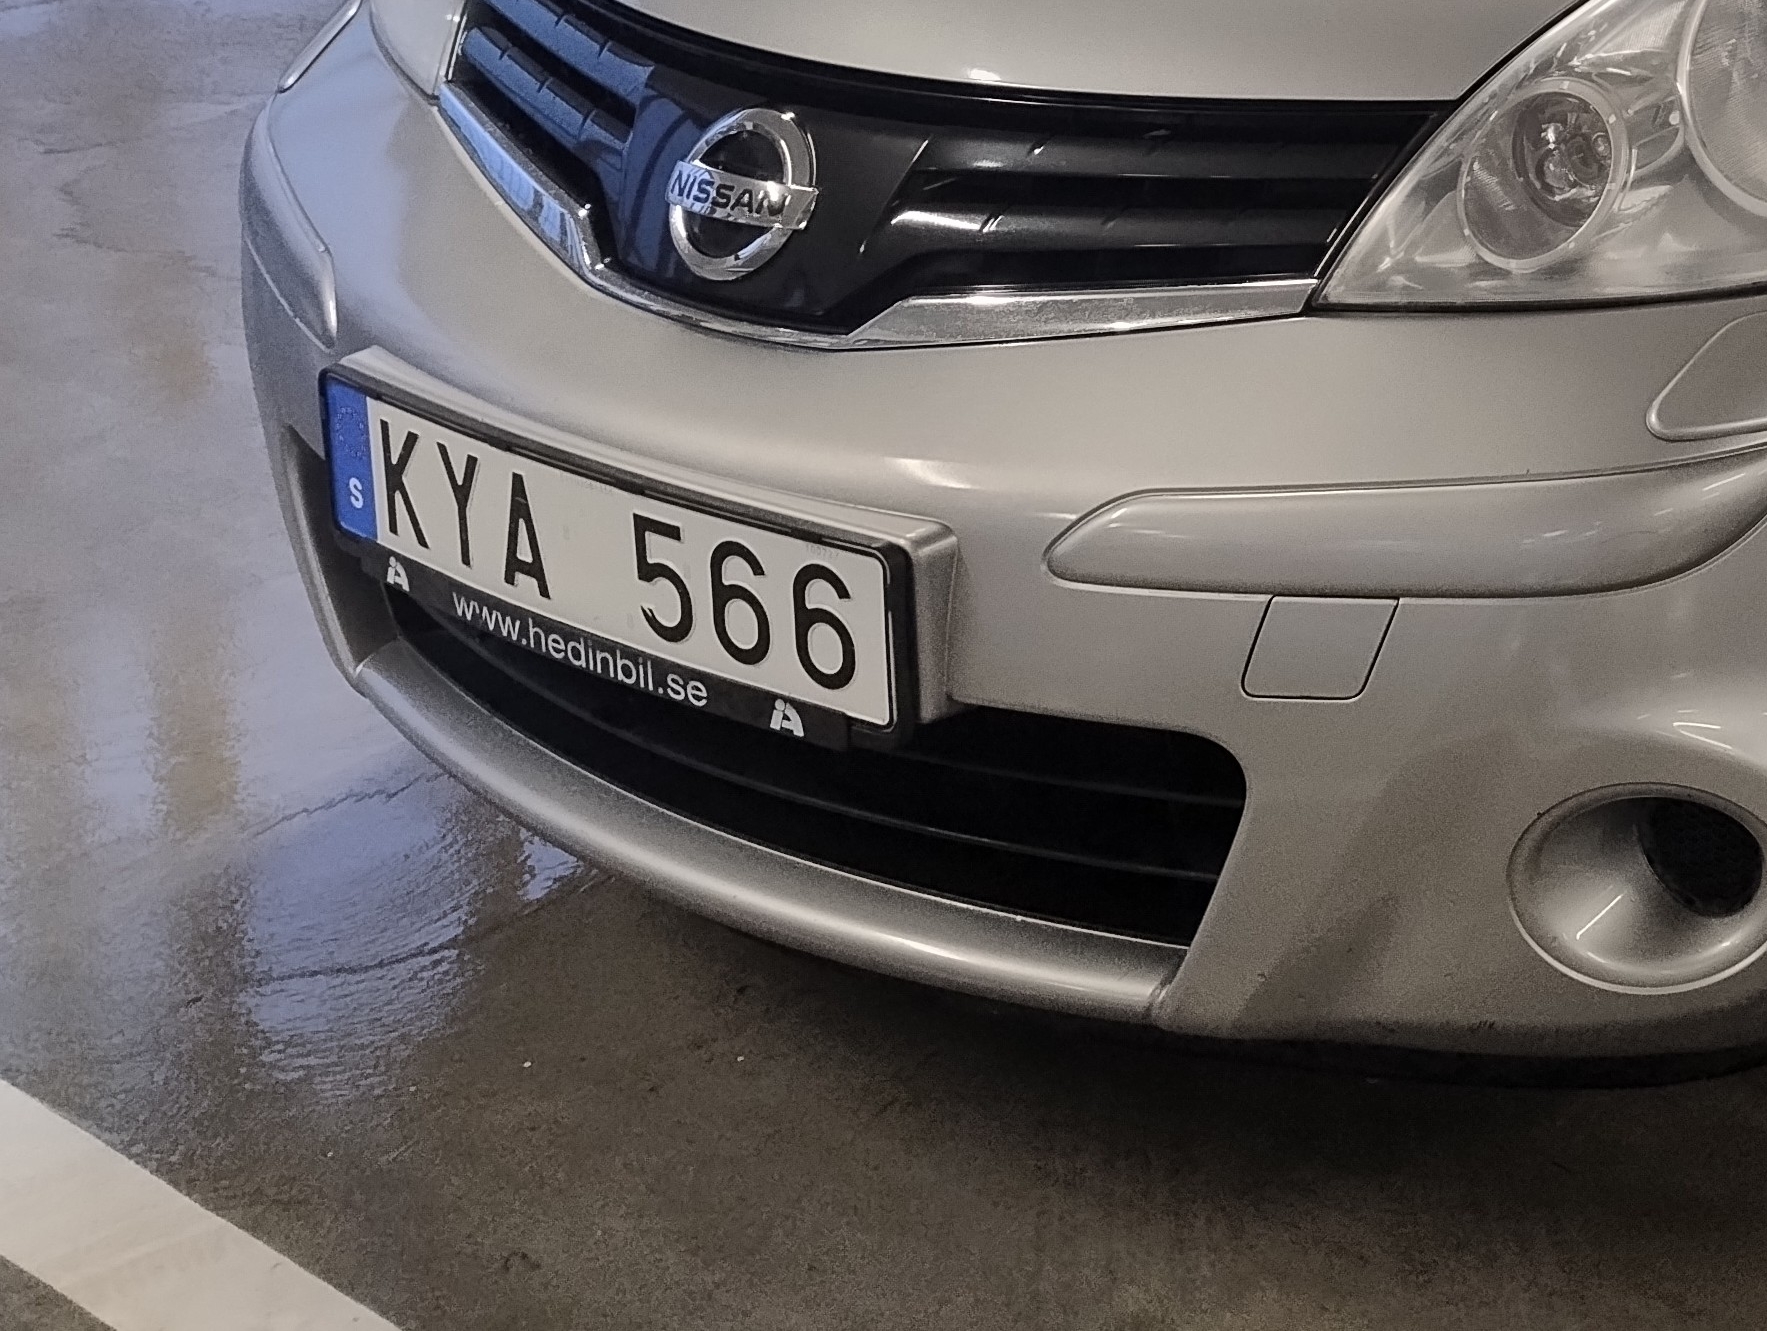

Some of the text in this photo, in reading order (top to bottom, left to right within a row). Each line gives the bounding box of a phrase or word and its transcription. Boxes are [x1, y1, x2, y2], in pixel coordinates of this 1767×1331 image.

[670, 171, 791, 217] NISSAN
[348, 476, 365, 509] S
[379, 418, 857, 691] KYA 566
[452, 591, 708, 707] www.hedinbil.se
